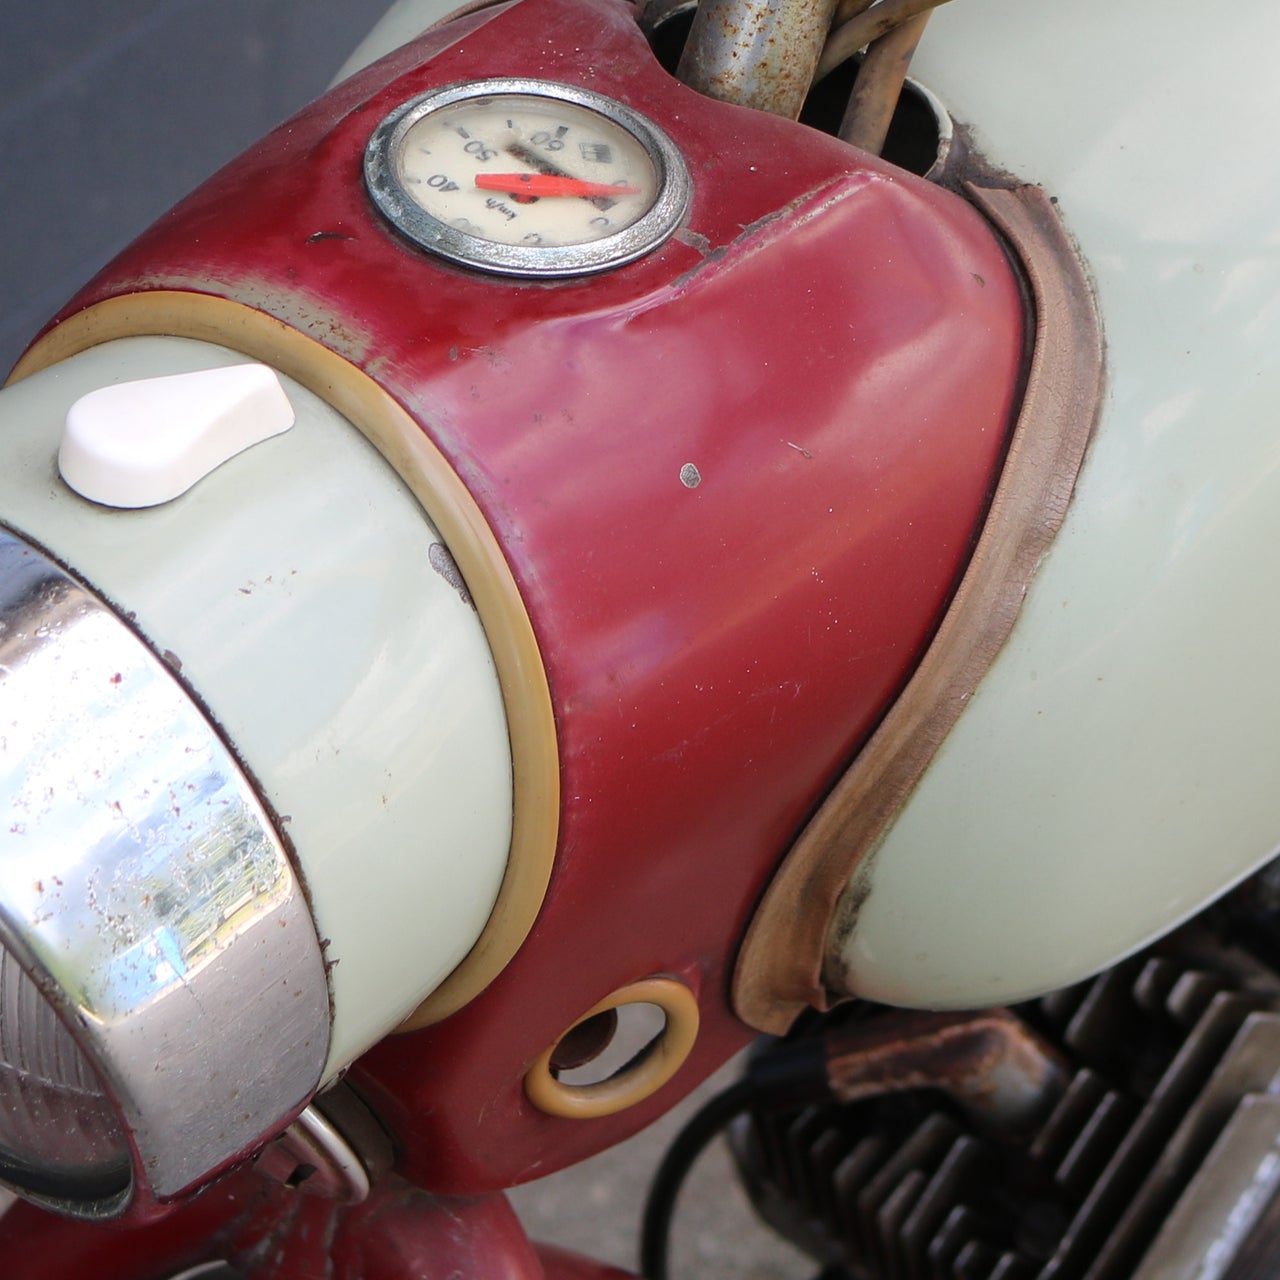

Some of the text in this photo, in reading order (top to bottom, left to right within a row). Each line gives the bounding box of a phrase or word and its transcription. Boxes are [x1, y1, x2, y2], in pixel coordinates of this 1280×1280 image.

[463, 140, 498, 162] 50
[529, 131, 566, 152] 60
[426, 174, 461, 193] 40
[485, 197, 518, 221] km/h
